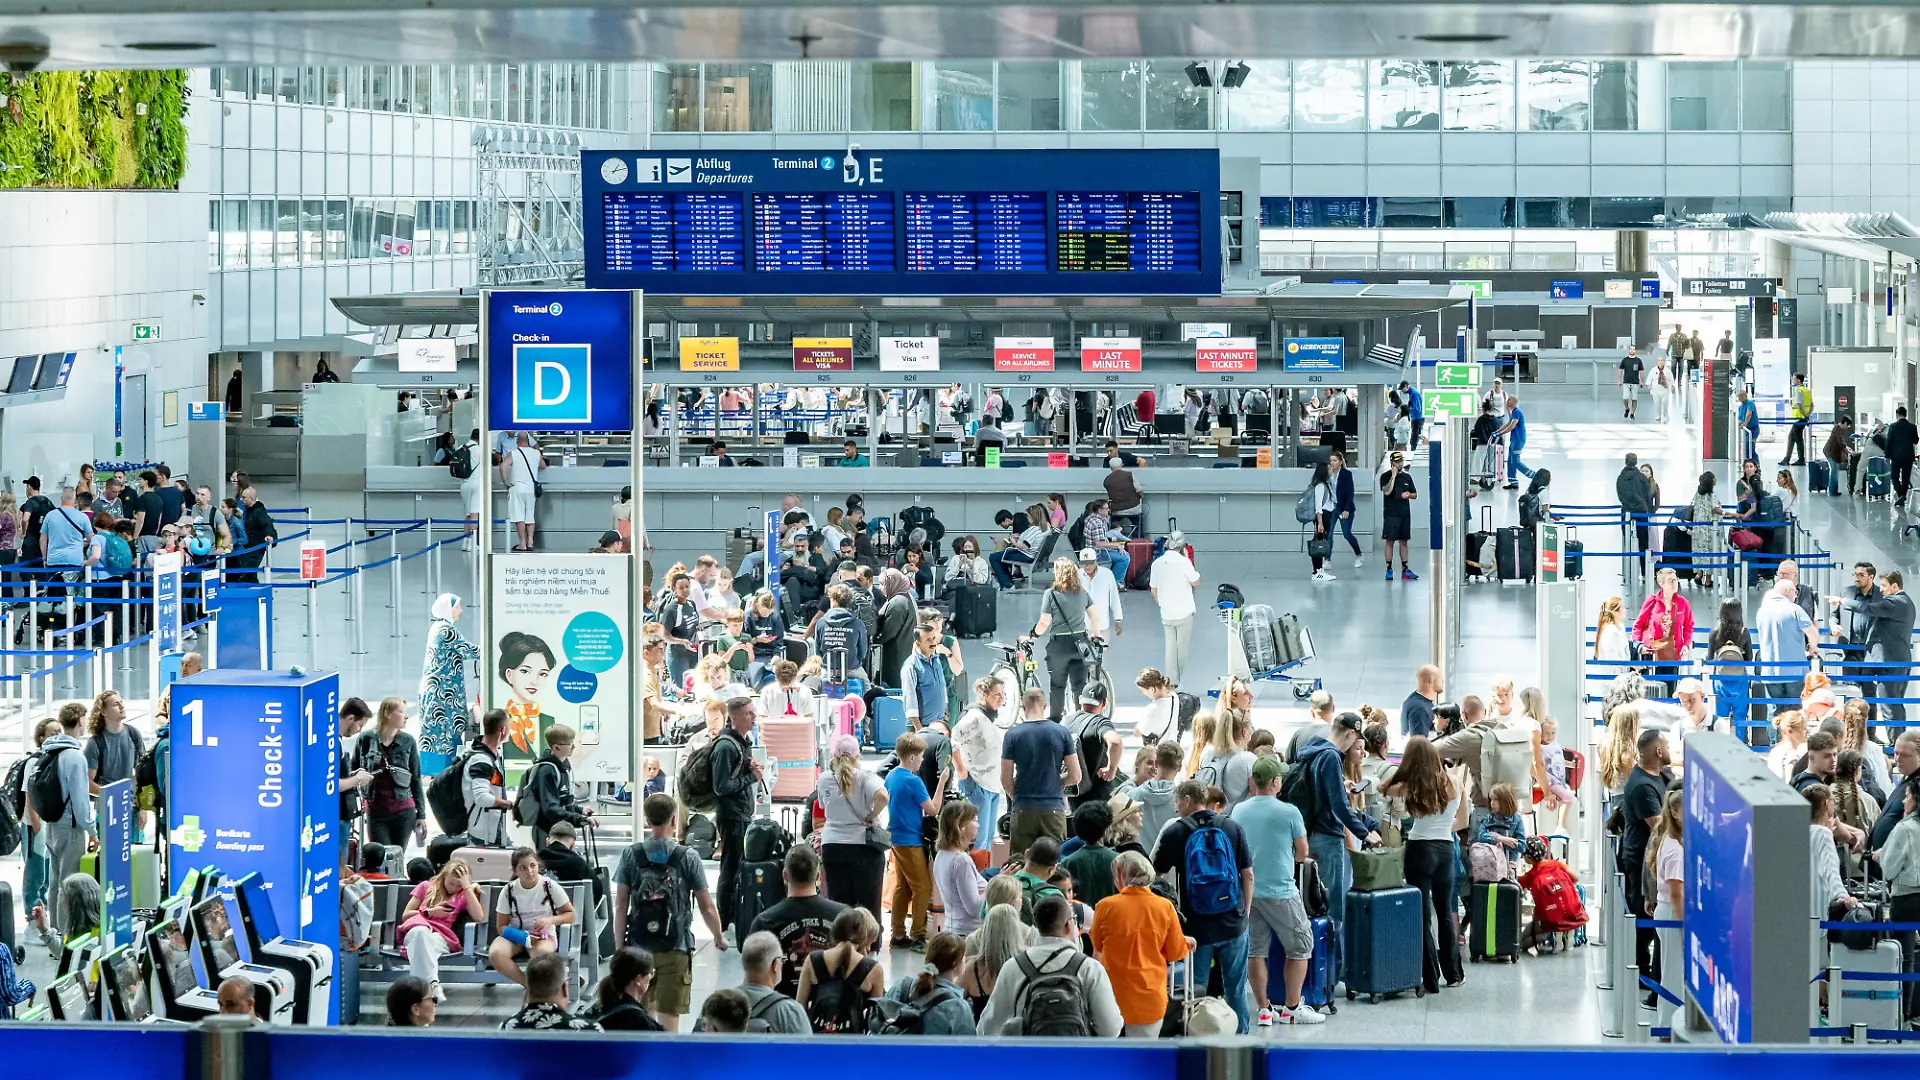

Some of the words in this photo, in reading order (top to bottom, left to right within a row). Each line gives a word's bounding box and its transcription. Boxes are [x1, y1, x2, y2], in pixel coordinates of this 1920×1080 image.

[696, 158, 731, 171] Abflug
[772, 158, 818, 169] Terminal
[870, 158, 884, 183] E
[696, 172, 754, 184] Departures
[512, 305, 548, 314] Terminal
[512, 333, 550, 342] Check-in
[894, 340, 924, 349] Ticket
[1100, 352, 1122, 360] LAST
[1199, 352, 1218, 360] LAST
[1220, 352, 1254, 360] MINUTE
[1092, 360, 1131, 369] MINUTE
[1210, 360, 1243, 369] TICKETS
[534, 361, 571, 406] D
[505, 567, 520, 576] Hãy
[521, 567, 535, 575] liên
[537, 567, 546, 577] hệ
[547, 567, 559, 575] với
[561, 567, 584, 576] chúng
[585, 567, 595, 575] tôi
[596, 567, 606, 575] và
[518, 577, 546, 587] nghiệm
[547, 577, 566, 585] niềm
[567, 577, 579, 585] vui
[522, 588, 532, 597] tại
[549, 587, 568, 597] hàng
[570, 587, 589, 595] Miễn
[590, 586, 612, 595] Thuế.
[181, 699, 219, 747] 1.
[304, 698, 318, 746] 1.
[326, 691, 335, 795] Check-in
[258, 702, 282, 808] Check-in
[106, 795, 117, 826] 1.
[121, 789, 129, 862] Check-in
[215, 829, 251, 839] Bordkarte
[215, 841, 247, 852] Boarding
[247, 844, 265, 852] pass
